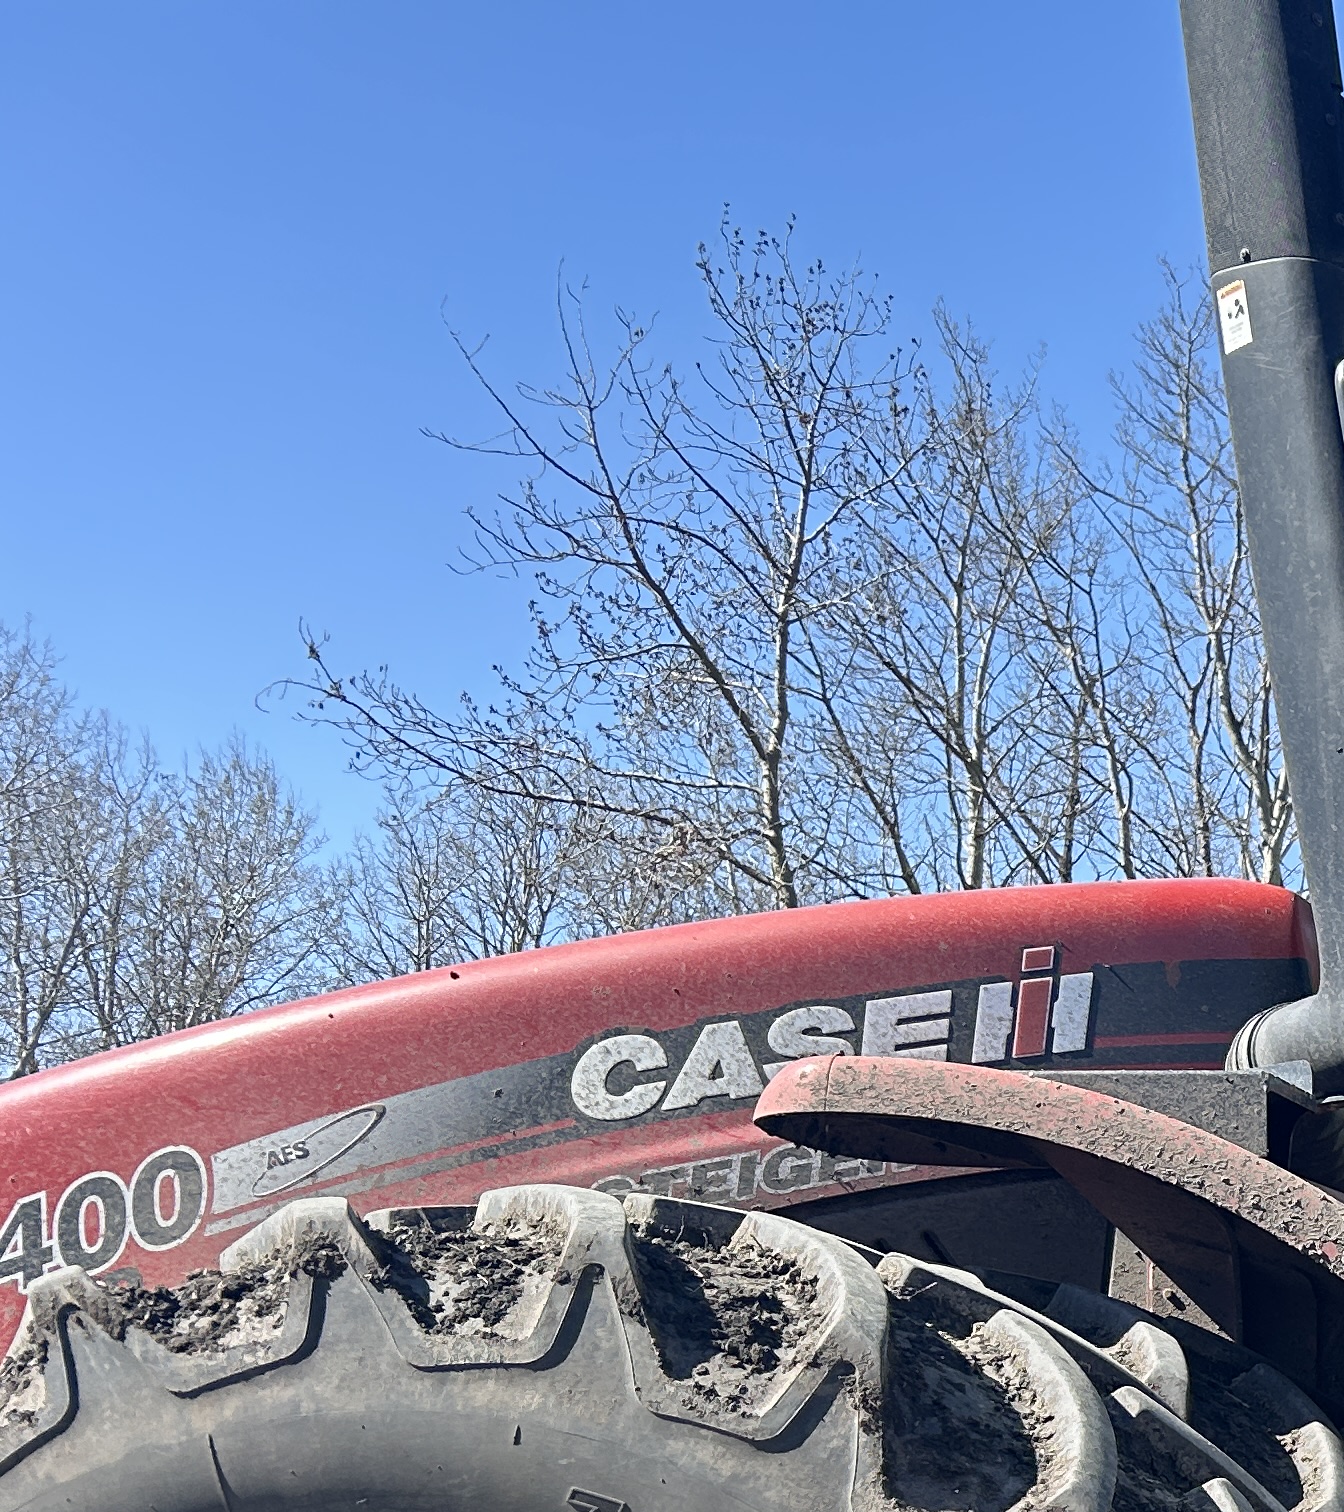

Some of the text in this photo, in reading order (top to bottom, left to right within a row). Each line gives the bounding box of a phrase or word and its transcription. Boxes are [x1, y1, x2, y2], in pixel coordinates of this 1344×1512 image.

[570, 989, 953, 1122] CASE
[265, 1139, 310, 1170] AFS
[589, 1142, 916, 1205] TEIGE
[0, 1145, 207, 1293] 400
